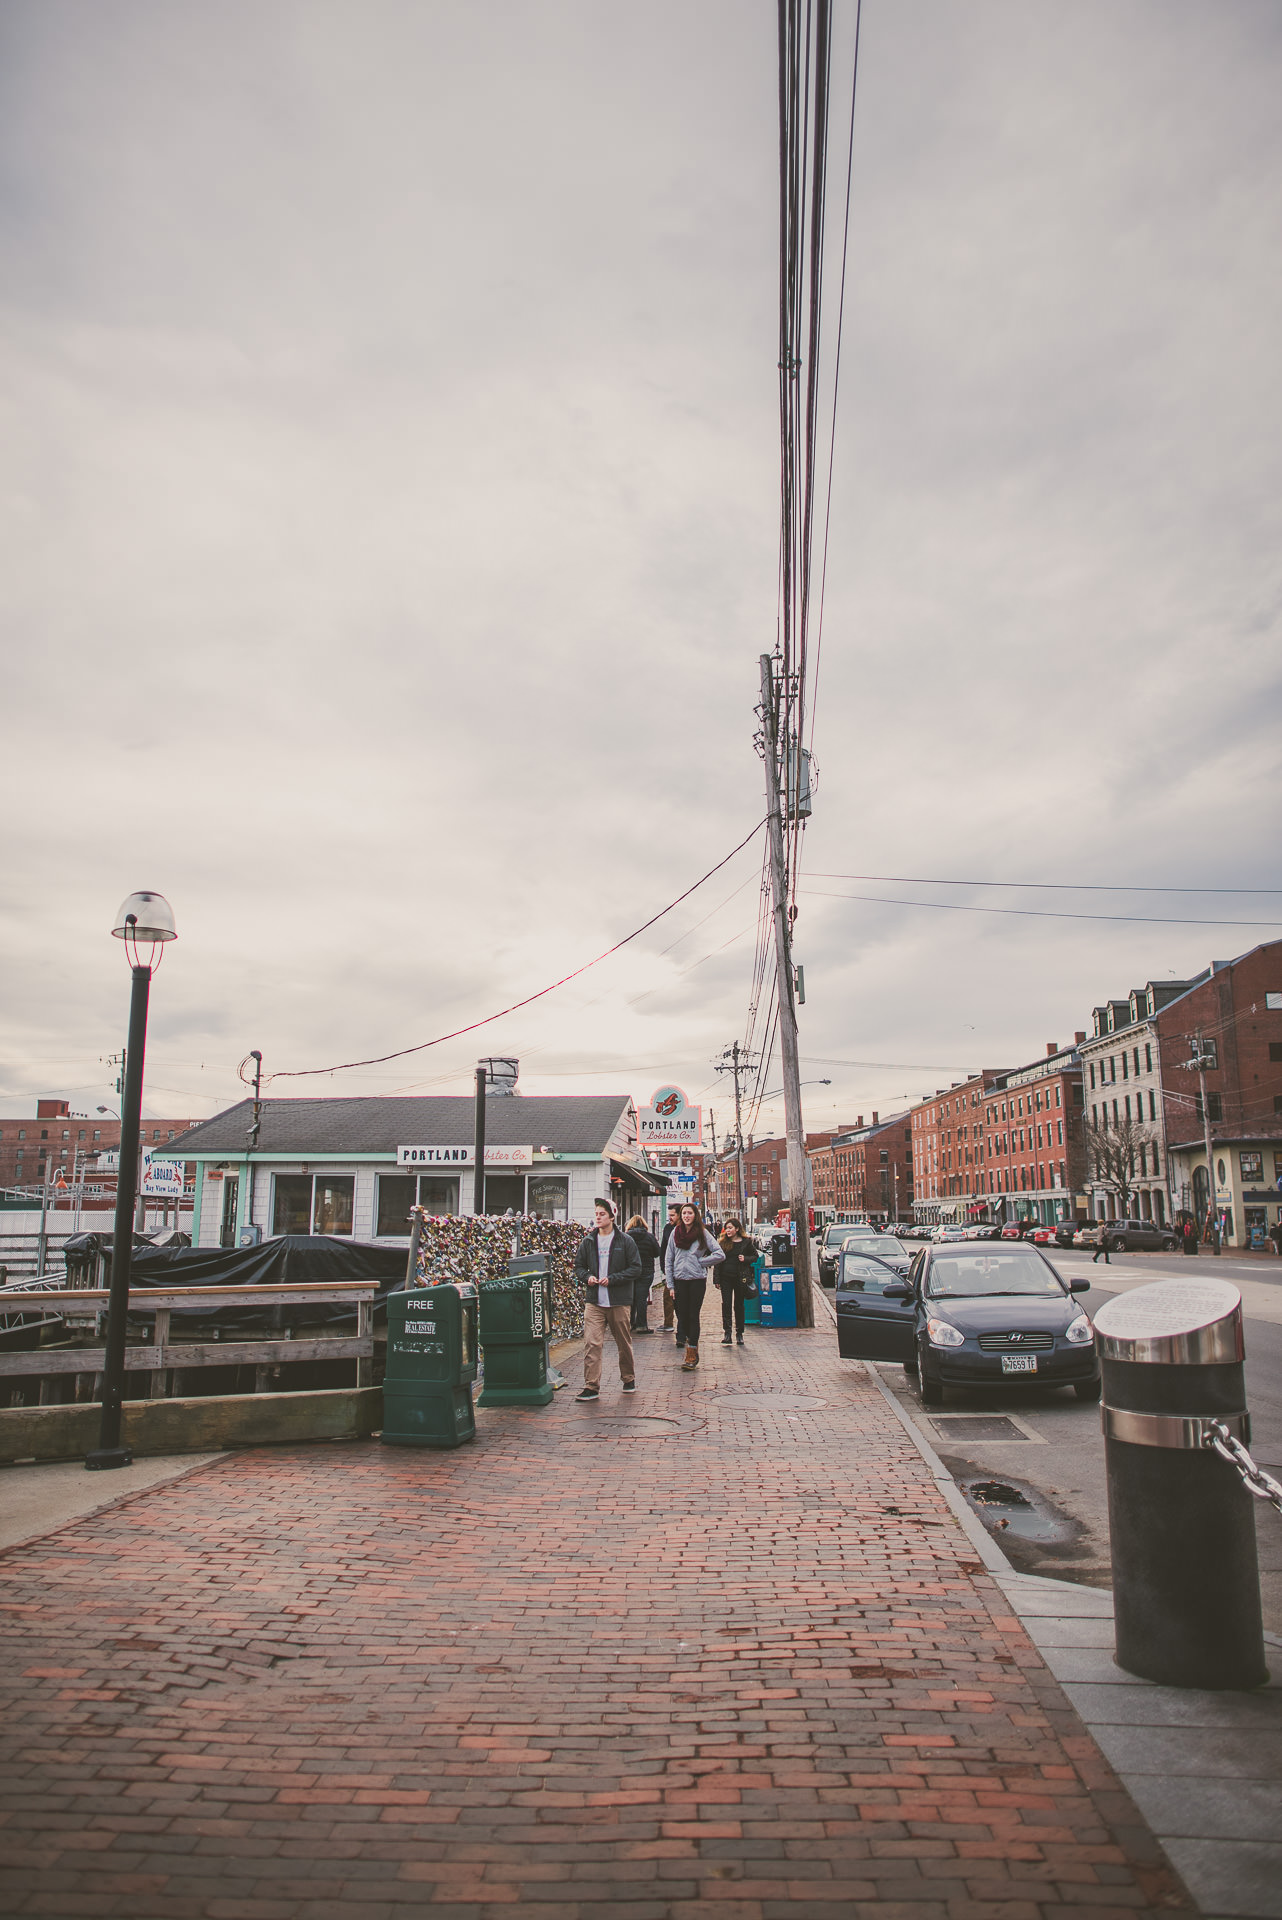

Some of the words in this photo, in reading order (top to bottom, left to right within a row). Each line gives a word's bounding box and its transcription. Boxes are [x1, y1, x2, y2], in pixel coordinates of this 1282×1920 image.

[642, 1120, 696, 1130] PORTLAND
[646, 1130, 678, 1140] Lobster
[680, 1130, 692, 1140] Co.
[403, 1150, 468, 1160] PORTLAND
[512, 1149, 527, 1160] Co.
[153, 1168, 172, 1180] ABOARD
[168, 1186, 178, 1194] Lady
[408, 1300, 434, 1310] FREE
[532, 1278, 542, 1338] FORECASTER
[1008, 1360, 1026, 1370] 7659
